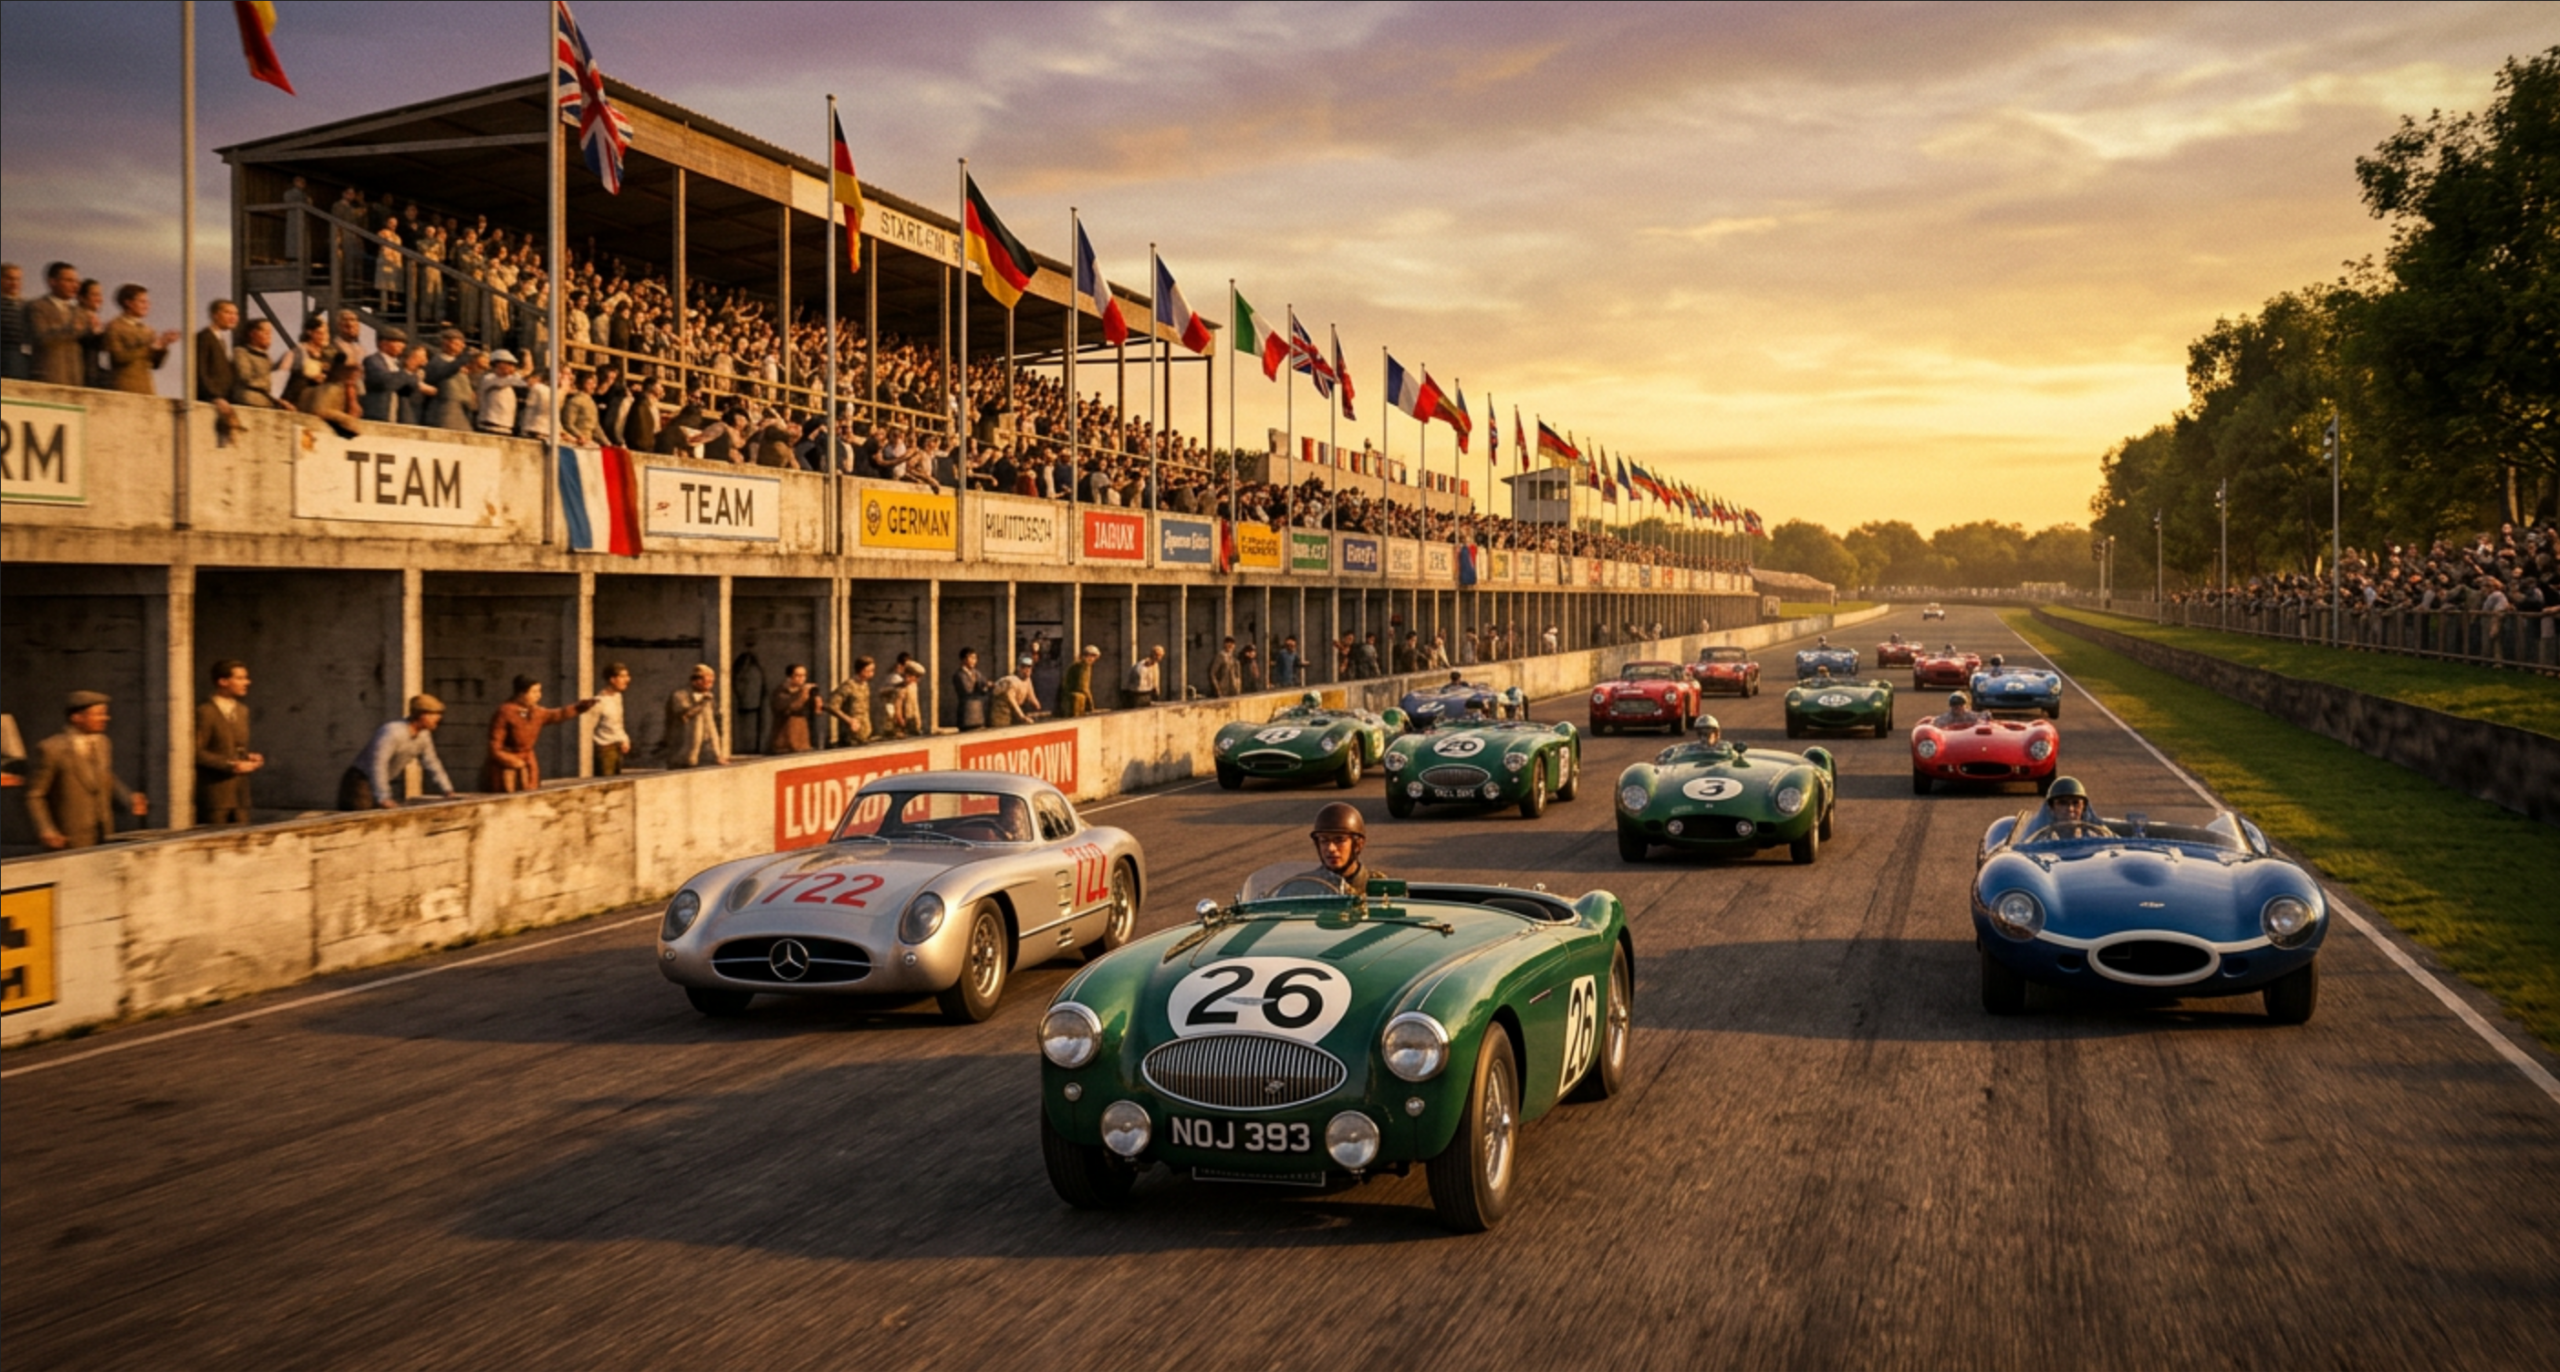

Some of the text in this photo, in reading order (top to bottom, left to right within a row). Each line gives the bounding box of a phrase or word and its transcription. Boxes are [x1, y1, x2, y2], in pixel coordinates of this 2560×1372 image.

[346, 450, 462, 509] TEAM
[680, 482, 754, 527] TEAM
[887, 505, 950, 537] GERMAN
[1698, 779, 1725, 797] 3
[762, 872, 885, 908] 722
[1184, 965, 1333, 1028] 26
[1564, 980, 1596, 1087] 26
[1171, 1116, 1311, 1152] NOJ 393
